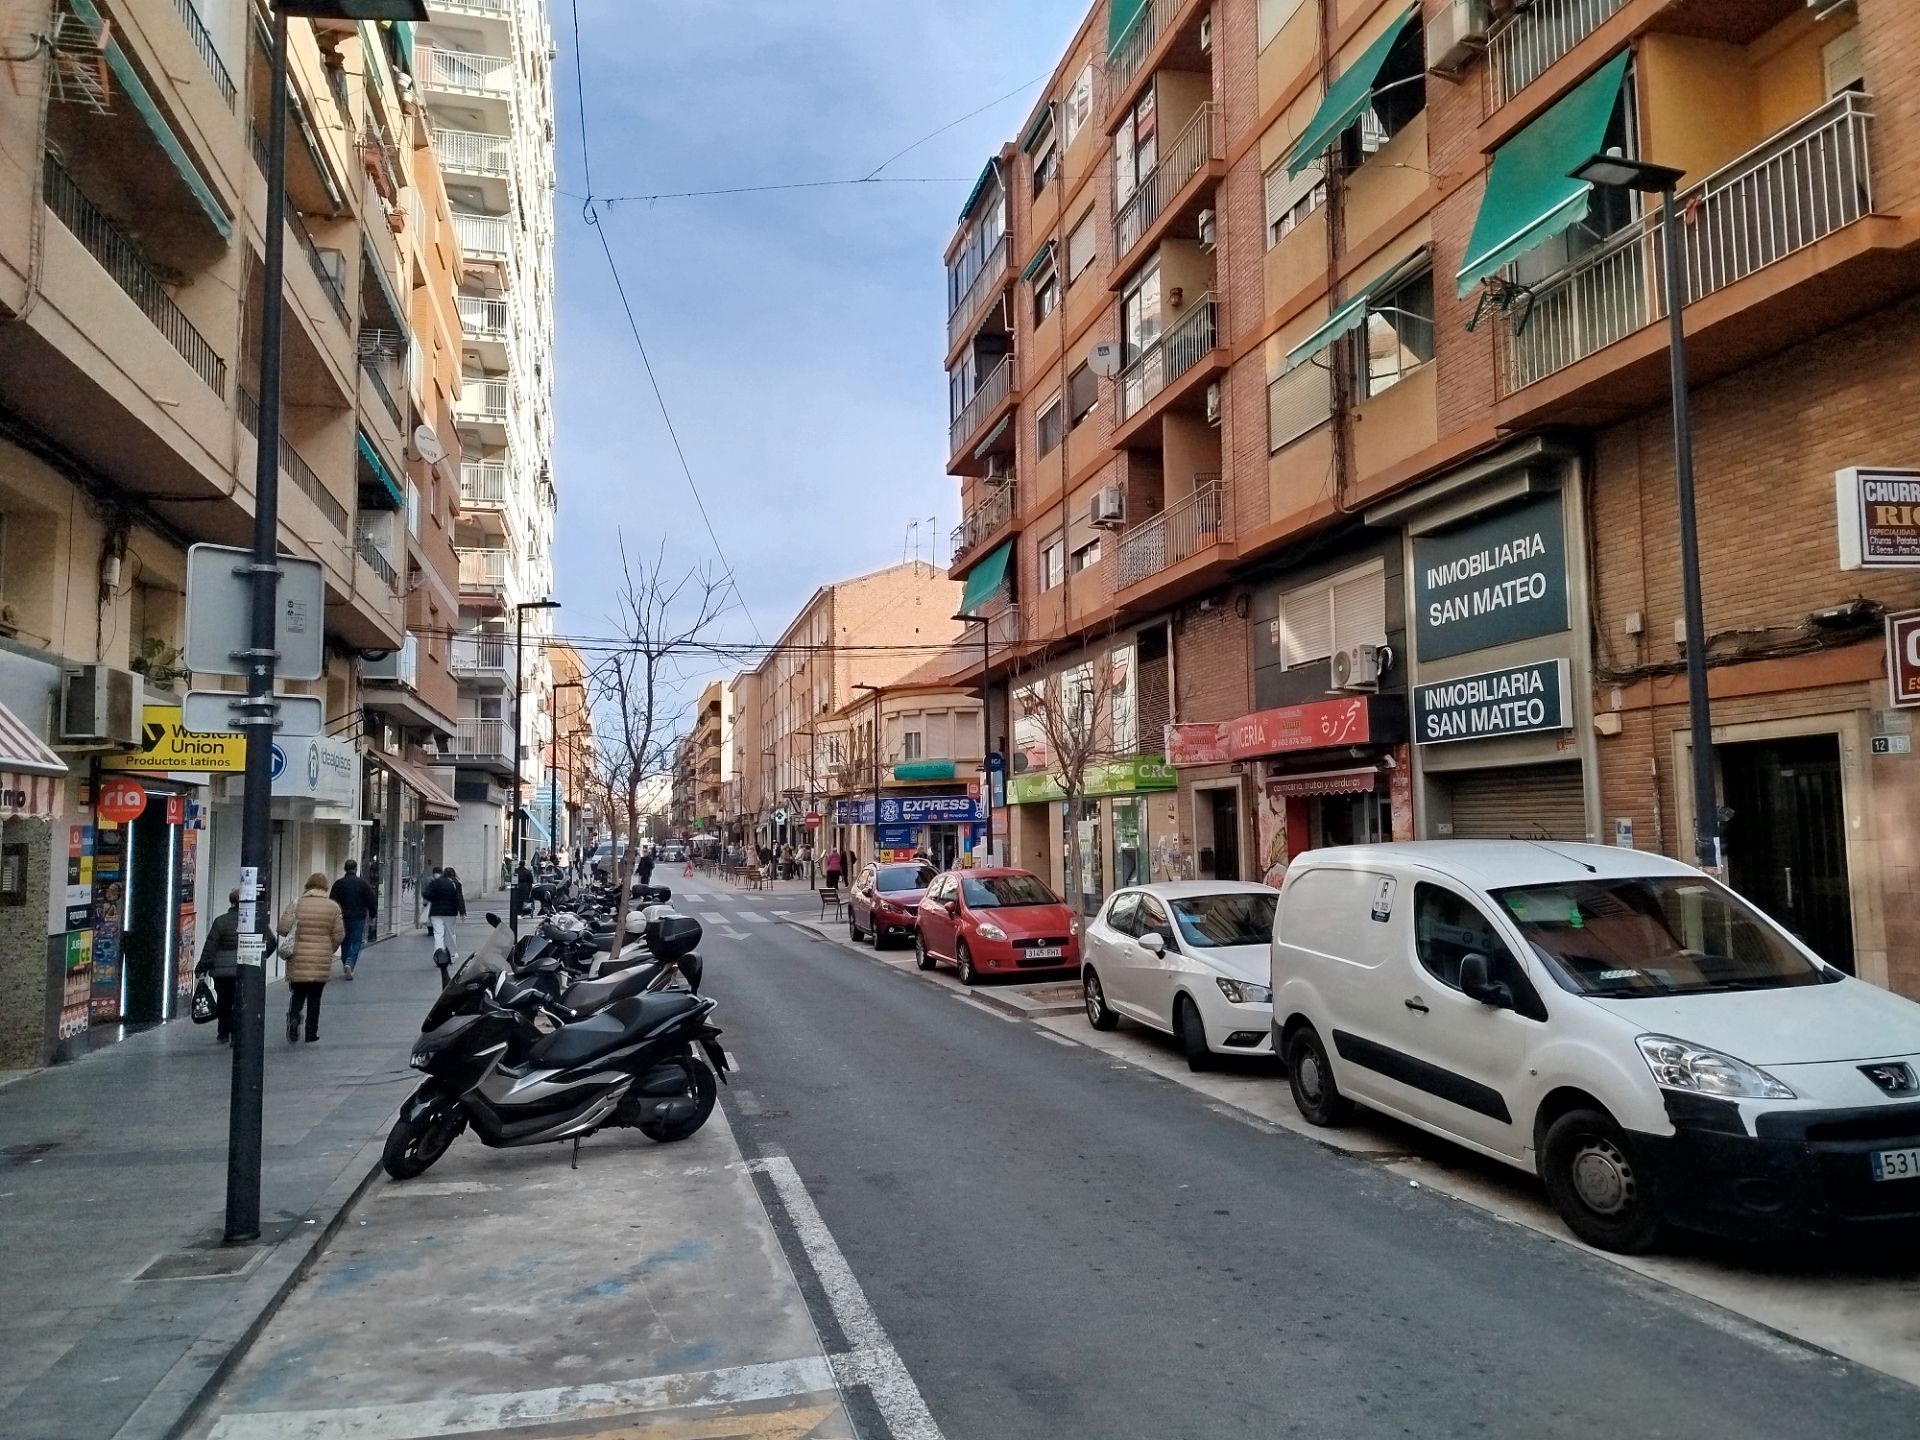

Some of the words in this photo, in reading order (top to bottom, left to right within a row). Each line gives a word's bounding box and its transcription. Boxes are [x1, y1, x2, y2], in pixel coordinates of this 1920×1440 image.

[1427, 533, 1545, 590] INMOBILIARIA
[1429, 594, 1470, 627] SAN
[1473, 572, 1547, 616] MATEO
[1425, 669, 1545, 711] INMOBILIARIA
[1427, 709, 1467, 738] SAN
[1471, 698, 1545, 733] MATEO
[171, 739, 225, 754] Union
[1875, 740, 1886, 750] 12
[125, 756, 187, 767] Productos
[190, 756, 231, 767] latinos
[1139, 764, 1174, 778] CRC
[103, 785, 141, 806] ria
[902, 799, 970, 812] EXPRESS
[1884, 1151, 1919, 1175] 531
